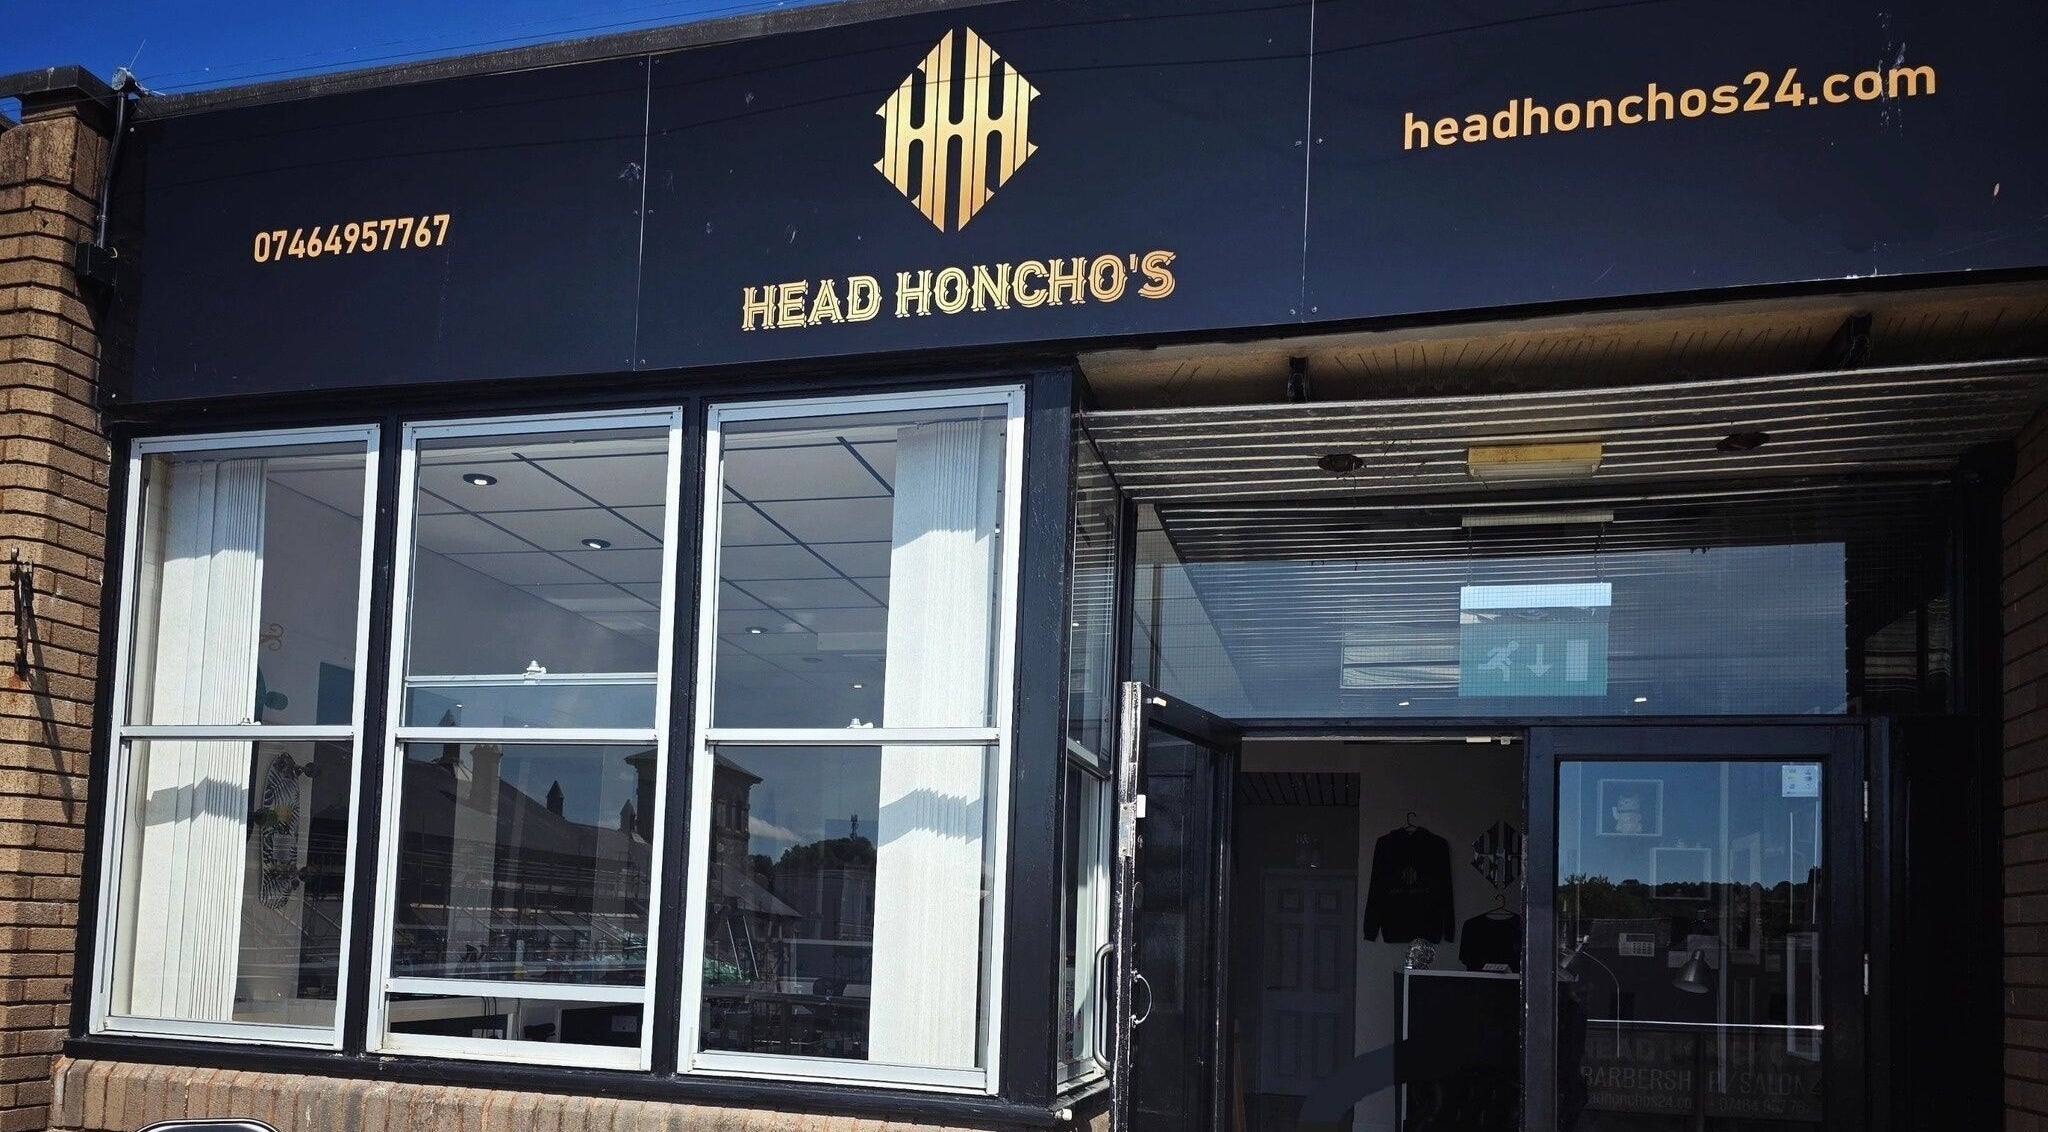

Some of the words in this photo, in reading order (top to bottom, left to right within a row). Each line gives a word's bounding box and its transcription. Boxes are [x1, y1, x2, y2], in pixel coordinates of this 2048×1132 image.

[1404, 65, 1936, 150] headhonchos24.com
[254, 213, 450, 263] 07464957767
[742, 275, 882, 331] HEAD
[895, 249, 1177, 318] HONCHO'S
